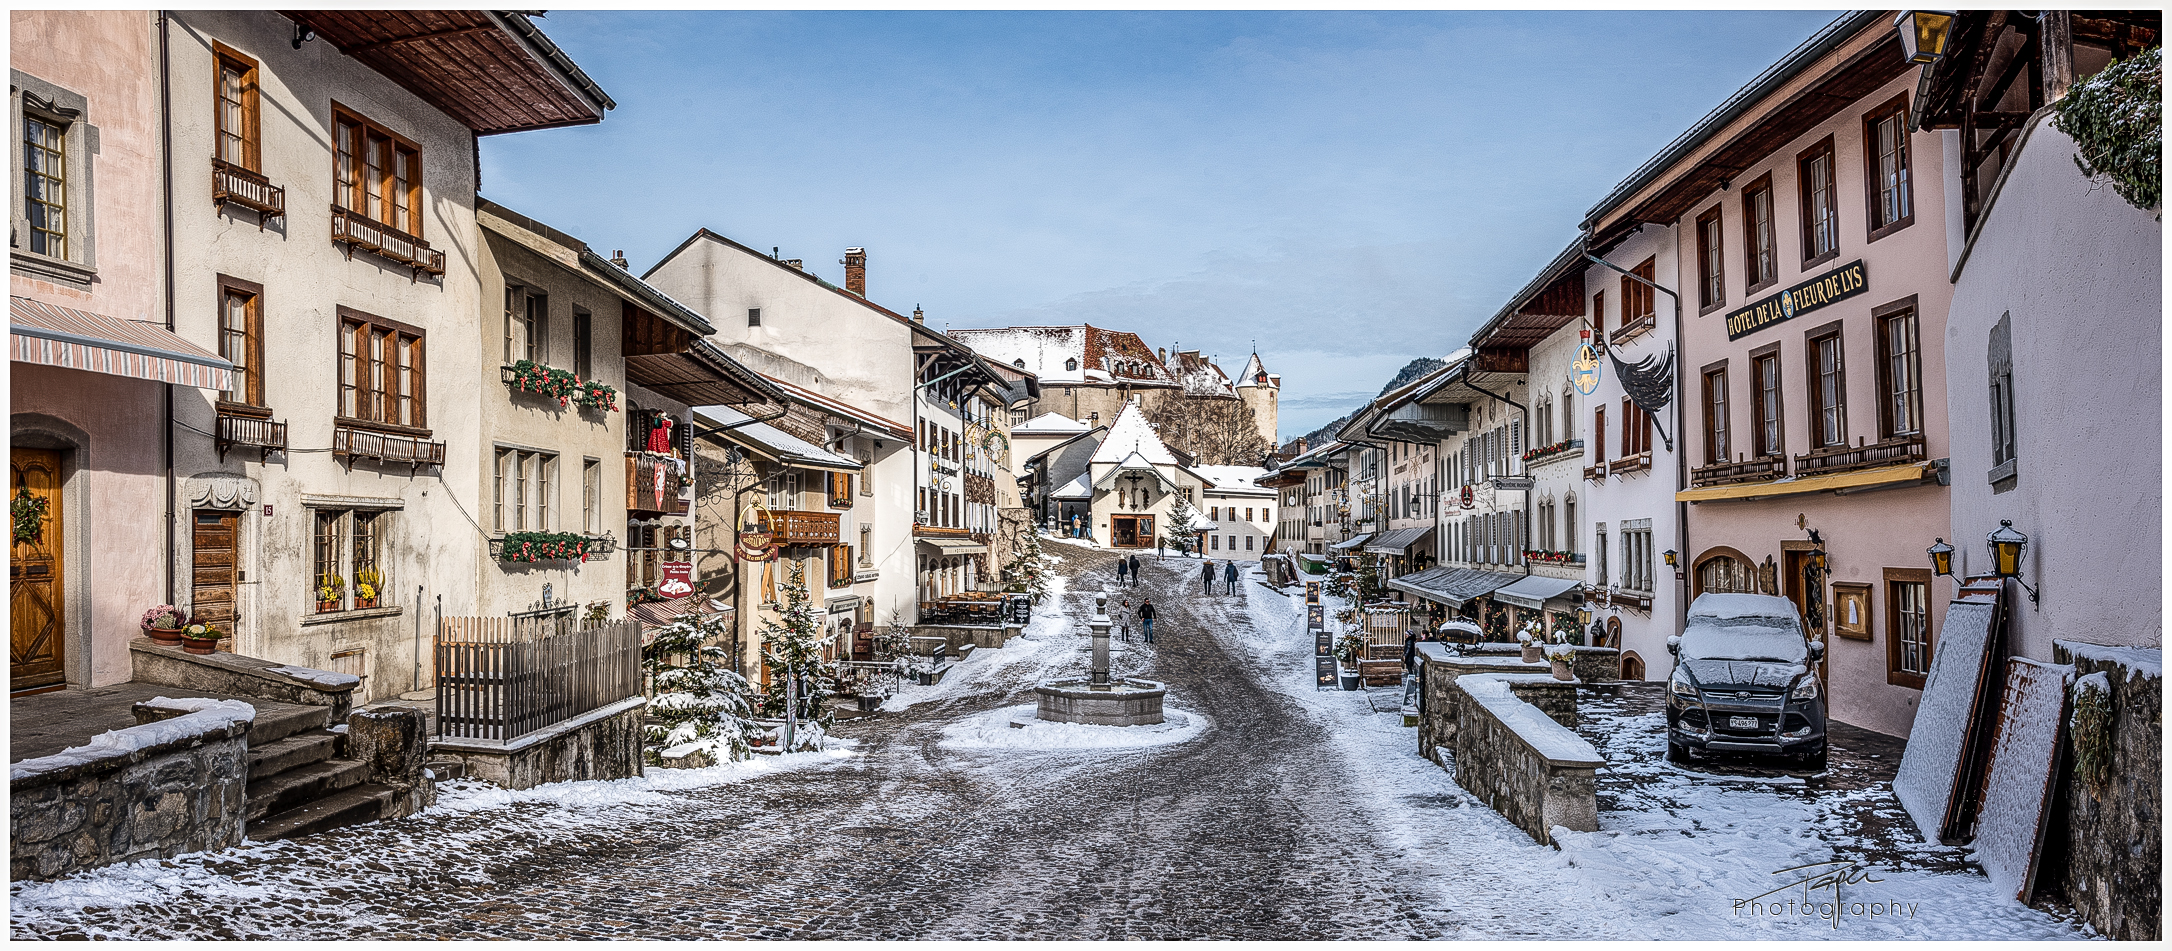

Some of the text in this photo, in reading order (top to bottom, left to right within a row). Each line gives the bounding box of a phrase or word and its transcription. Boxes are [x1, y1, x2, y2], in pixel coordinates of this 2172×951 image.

[1728, 265, 1863, 336] HOTEL DE LA FLEUR DE LYS
[265, 506, 272, 515] 15
[746, 547, 776, 561] Remparts
